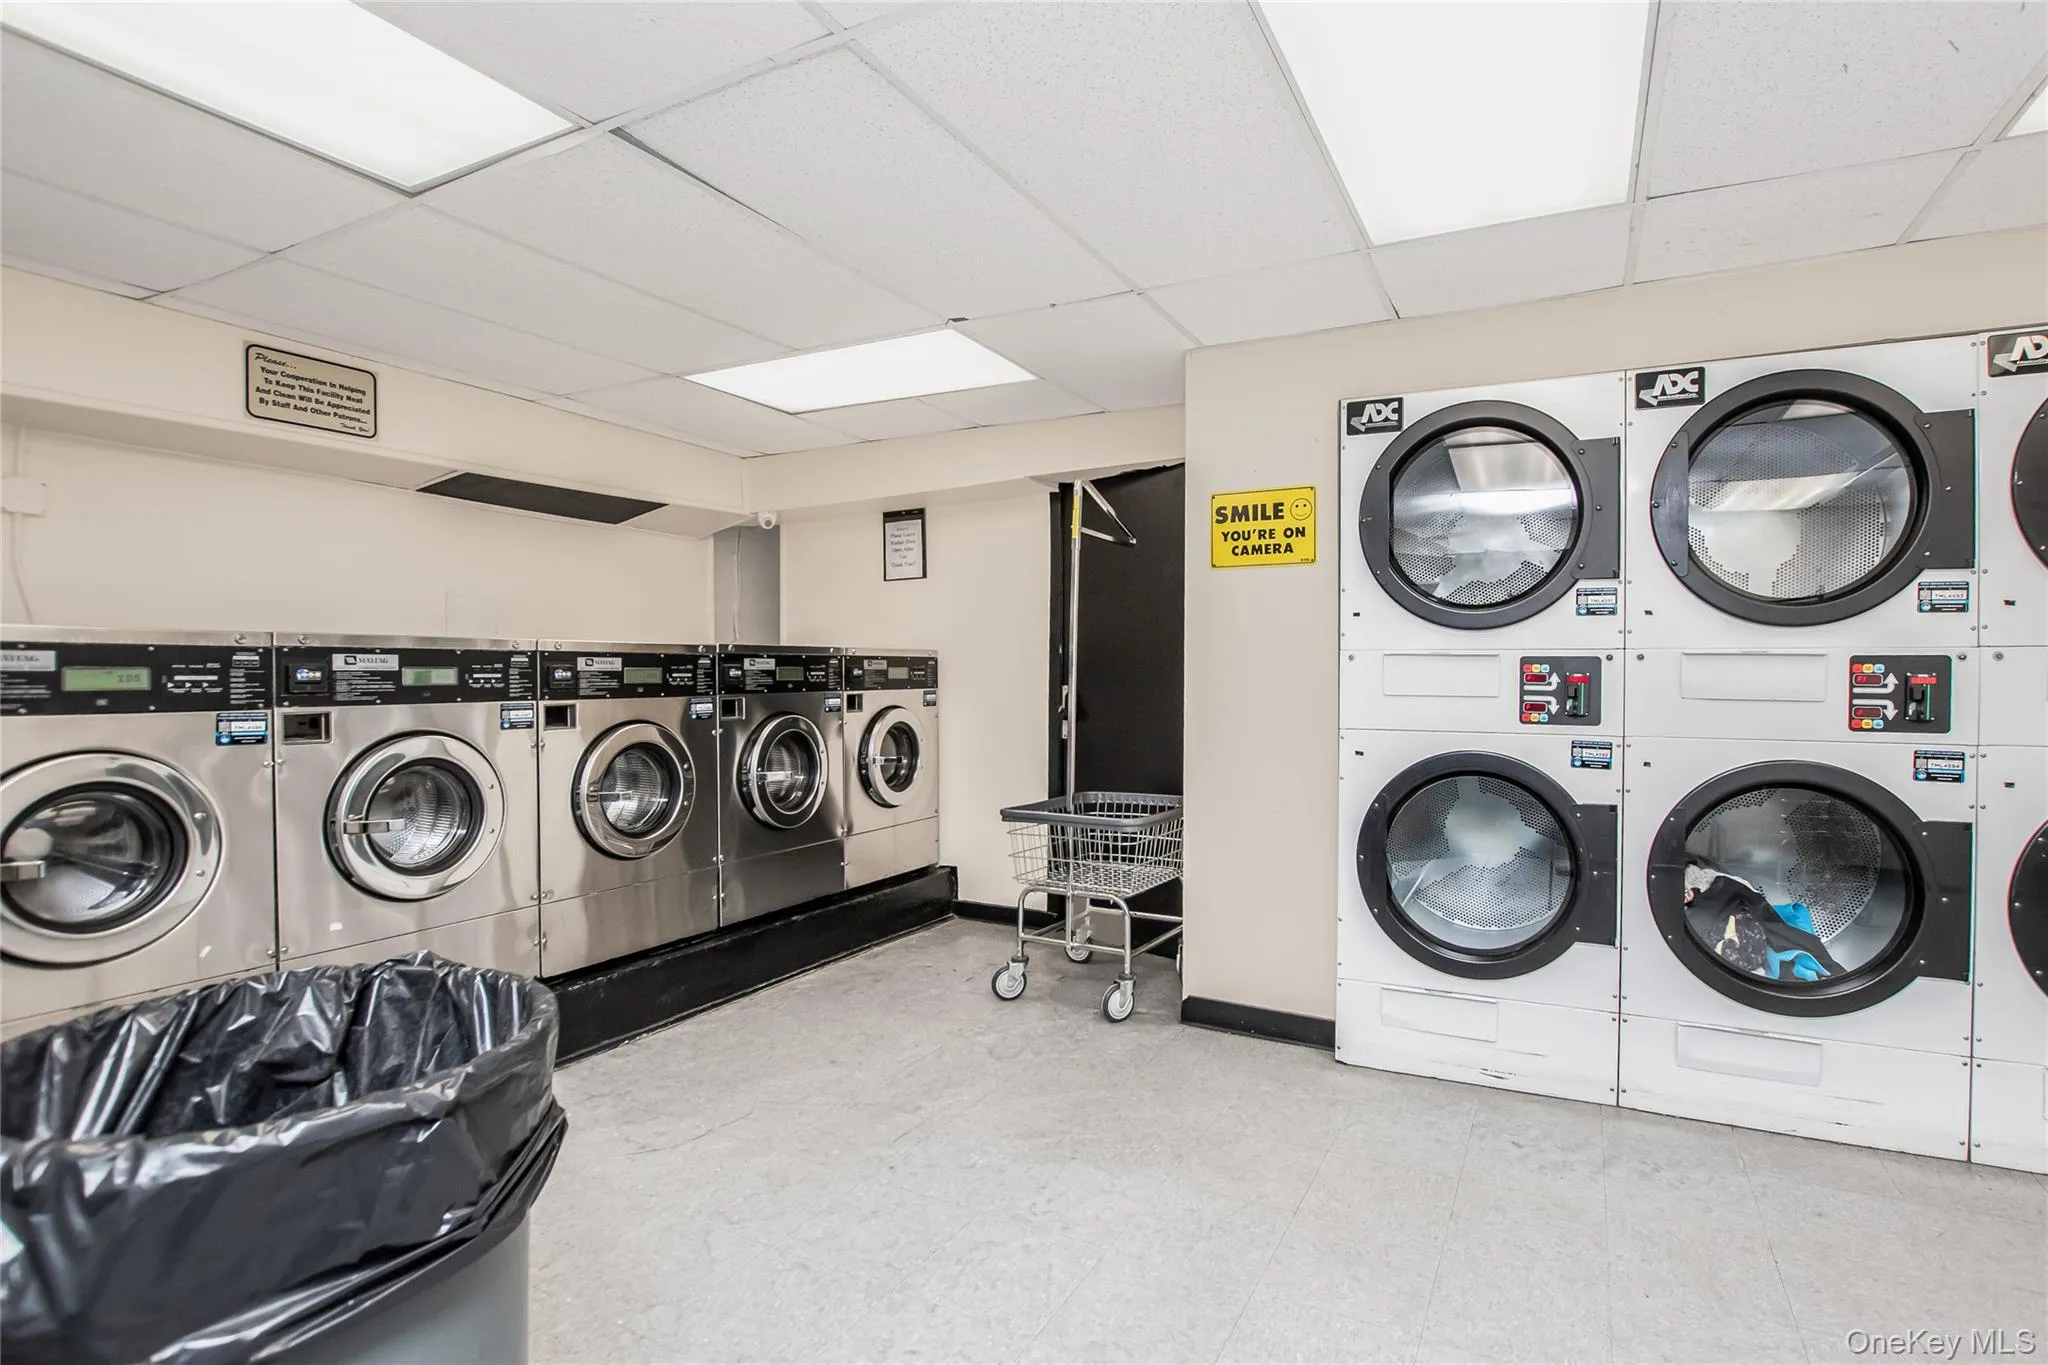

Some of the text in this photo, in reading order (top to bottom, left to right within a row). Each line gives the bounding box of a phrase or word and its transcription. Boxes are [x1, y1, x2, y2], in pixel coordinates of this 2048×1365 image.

[260, 366, 279, 376] Your
[280, 371, 328, 387] Cooperation
[338, 383, 367, 396] Helping
[264, 377, 273, 385] To
[275, 379, 296, 391] Keep
[298, 384, 315, 394] This
[316, 388, 344, 401] Facility
[1653, 371, 1699, 395] ADC
[255, 386, 371, 416] And Clean Will Be Appreciated
[259, 397, 270, 407] By
[271, 399, 291, 410] Staff
[292, 403, 308, 413] And
[310, 407, 332, 417] Other
[1361, 401, 1398, 423] ADC
[1215, 502, 1285, 524] SMILE
[1221, 526, 1306, 542] YOU'RE ON
[1231, 542, 1294, 556] CAMERA
